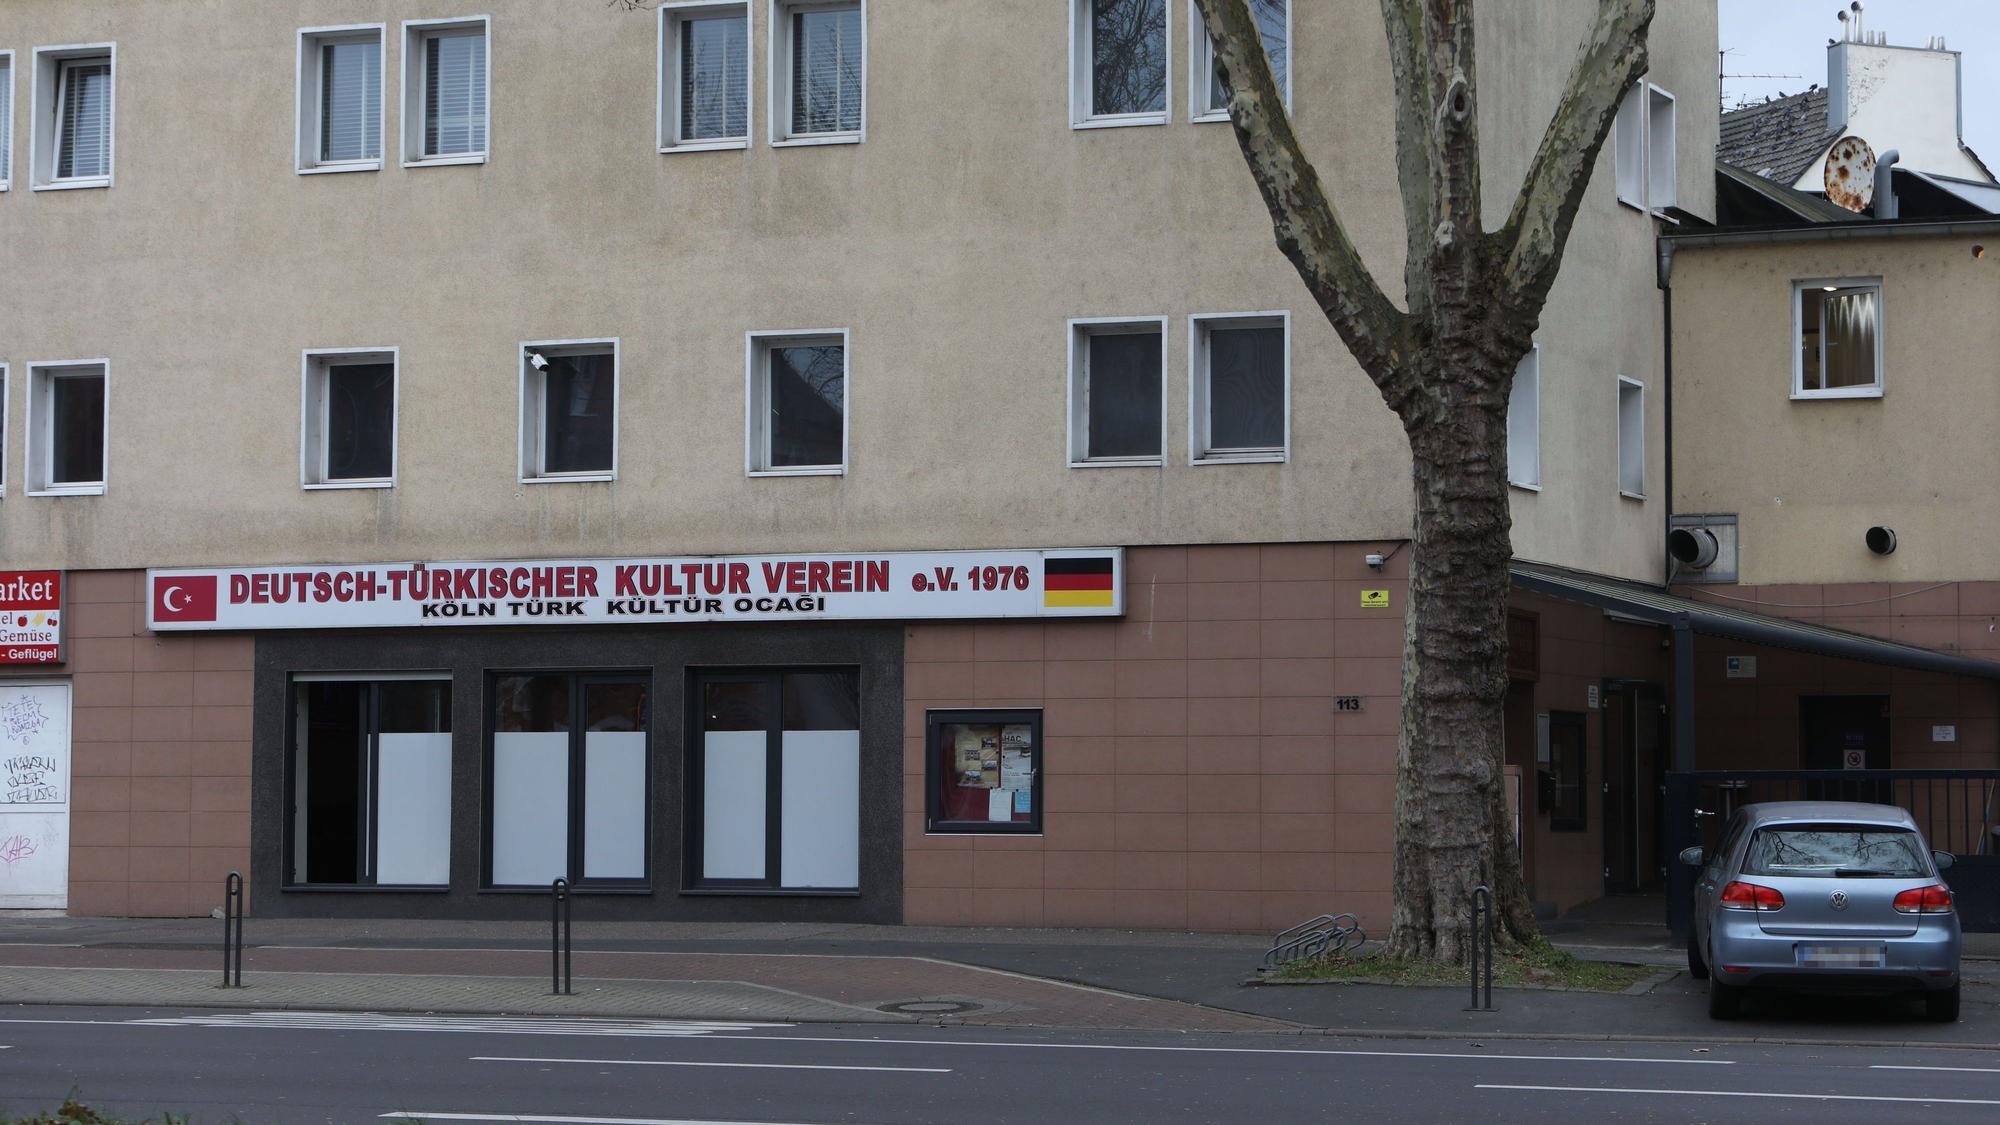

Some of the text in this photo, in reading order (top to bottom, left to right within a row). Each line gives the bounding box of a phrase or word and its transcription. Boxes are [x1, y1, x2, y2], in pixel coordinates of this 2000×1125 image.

[230, 560, 1030, 604] DEUTSCH-TÜRKISCHER KULTUR VEREIN e.V. 1976
[422, 594, 825, 618] KÖLN TÜRK KÜLTÜR OCAĞI
[0, 629, 52, 642] Gemüse
[8, 648, 57, 661] Geflügel
[1337, 699, 1360, 710] 113
